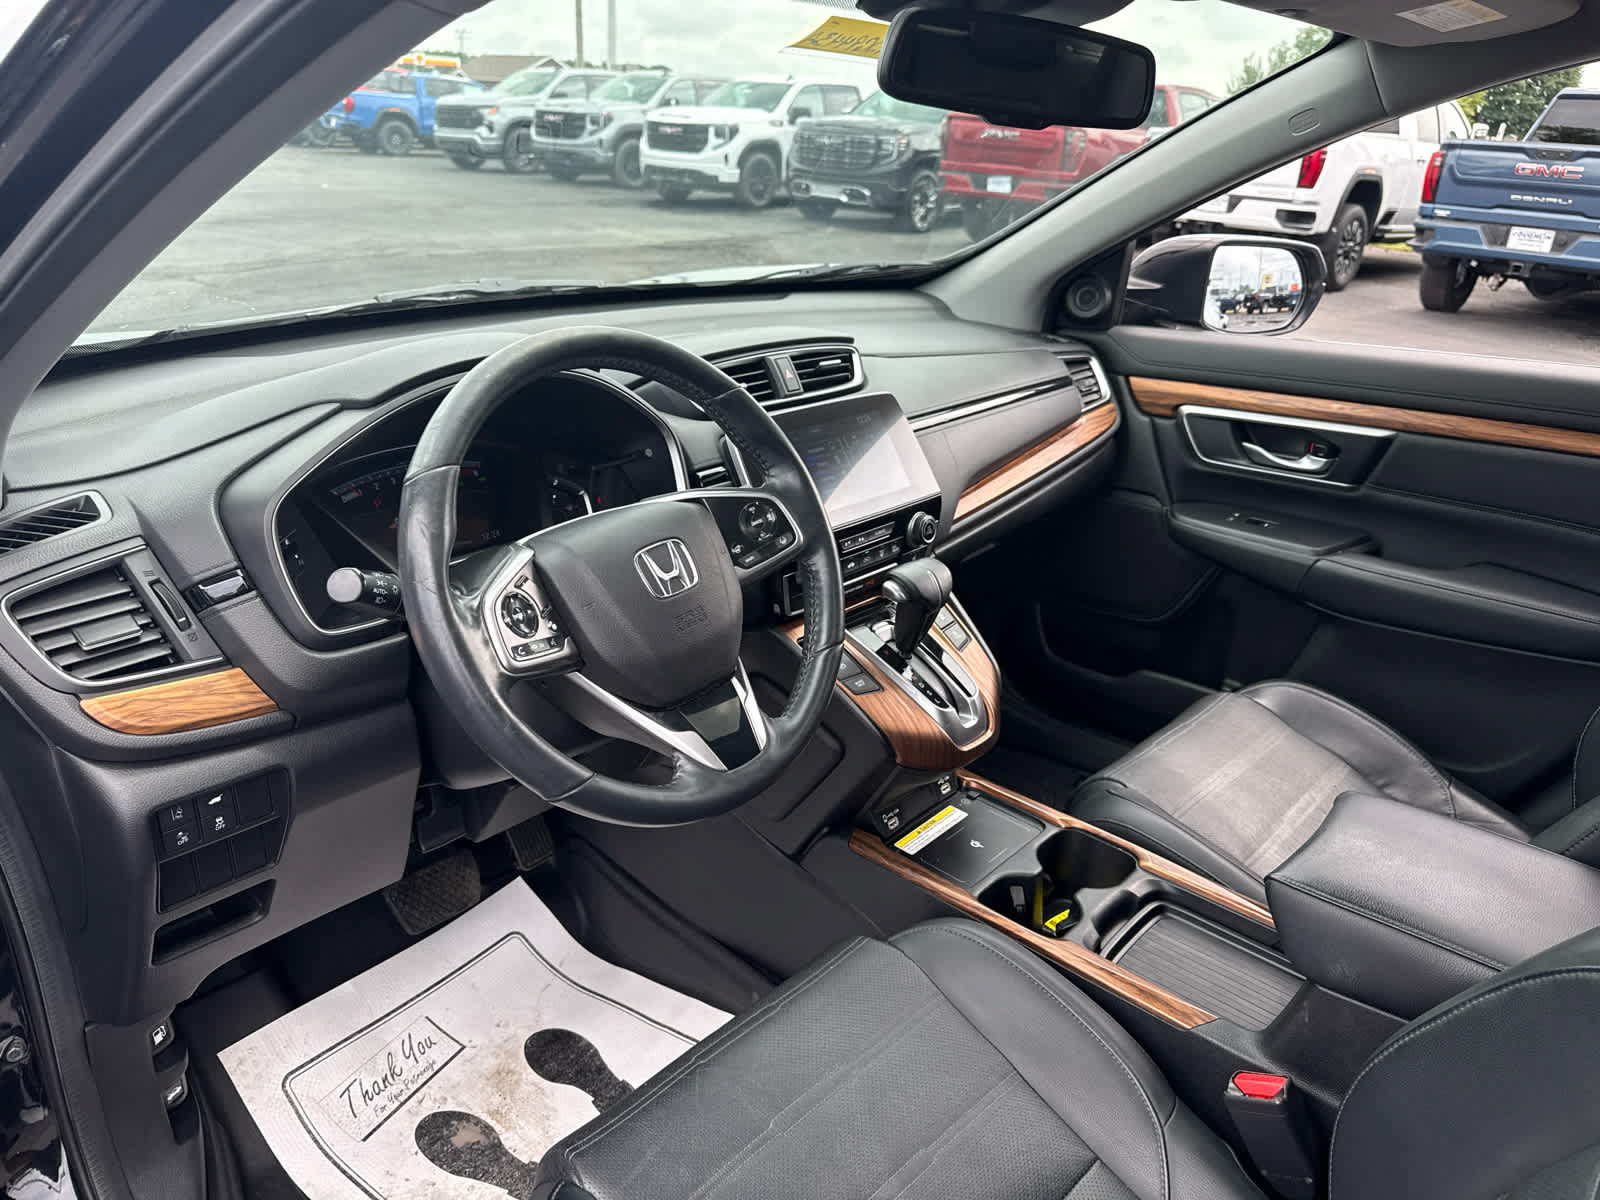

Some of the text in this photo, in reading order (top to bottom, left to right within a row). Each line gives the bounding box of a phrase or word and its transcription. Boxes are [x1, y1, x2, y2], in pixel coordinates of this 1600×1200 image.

[1514, 163, 1585, 179] GMC
[1510, 194, 1573, 205] DENALI
[373, 588, 386, 596] AUTO
[340, 1033, 437, 1118] Thank You
